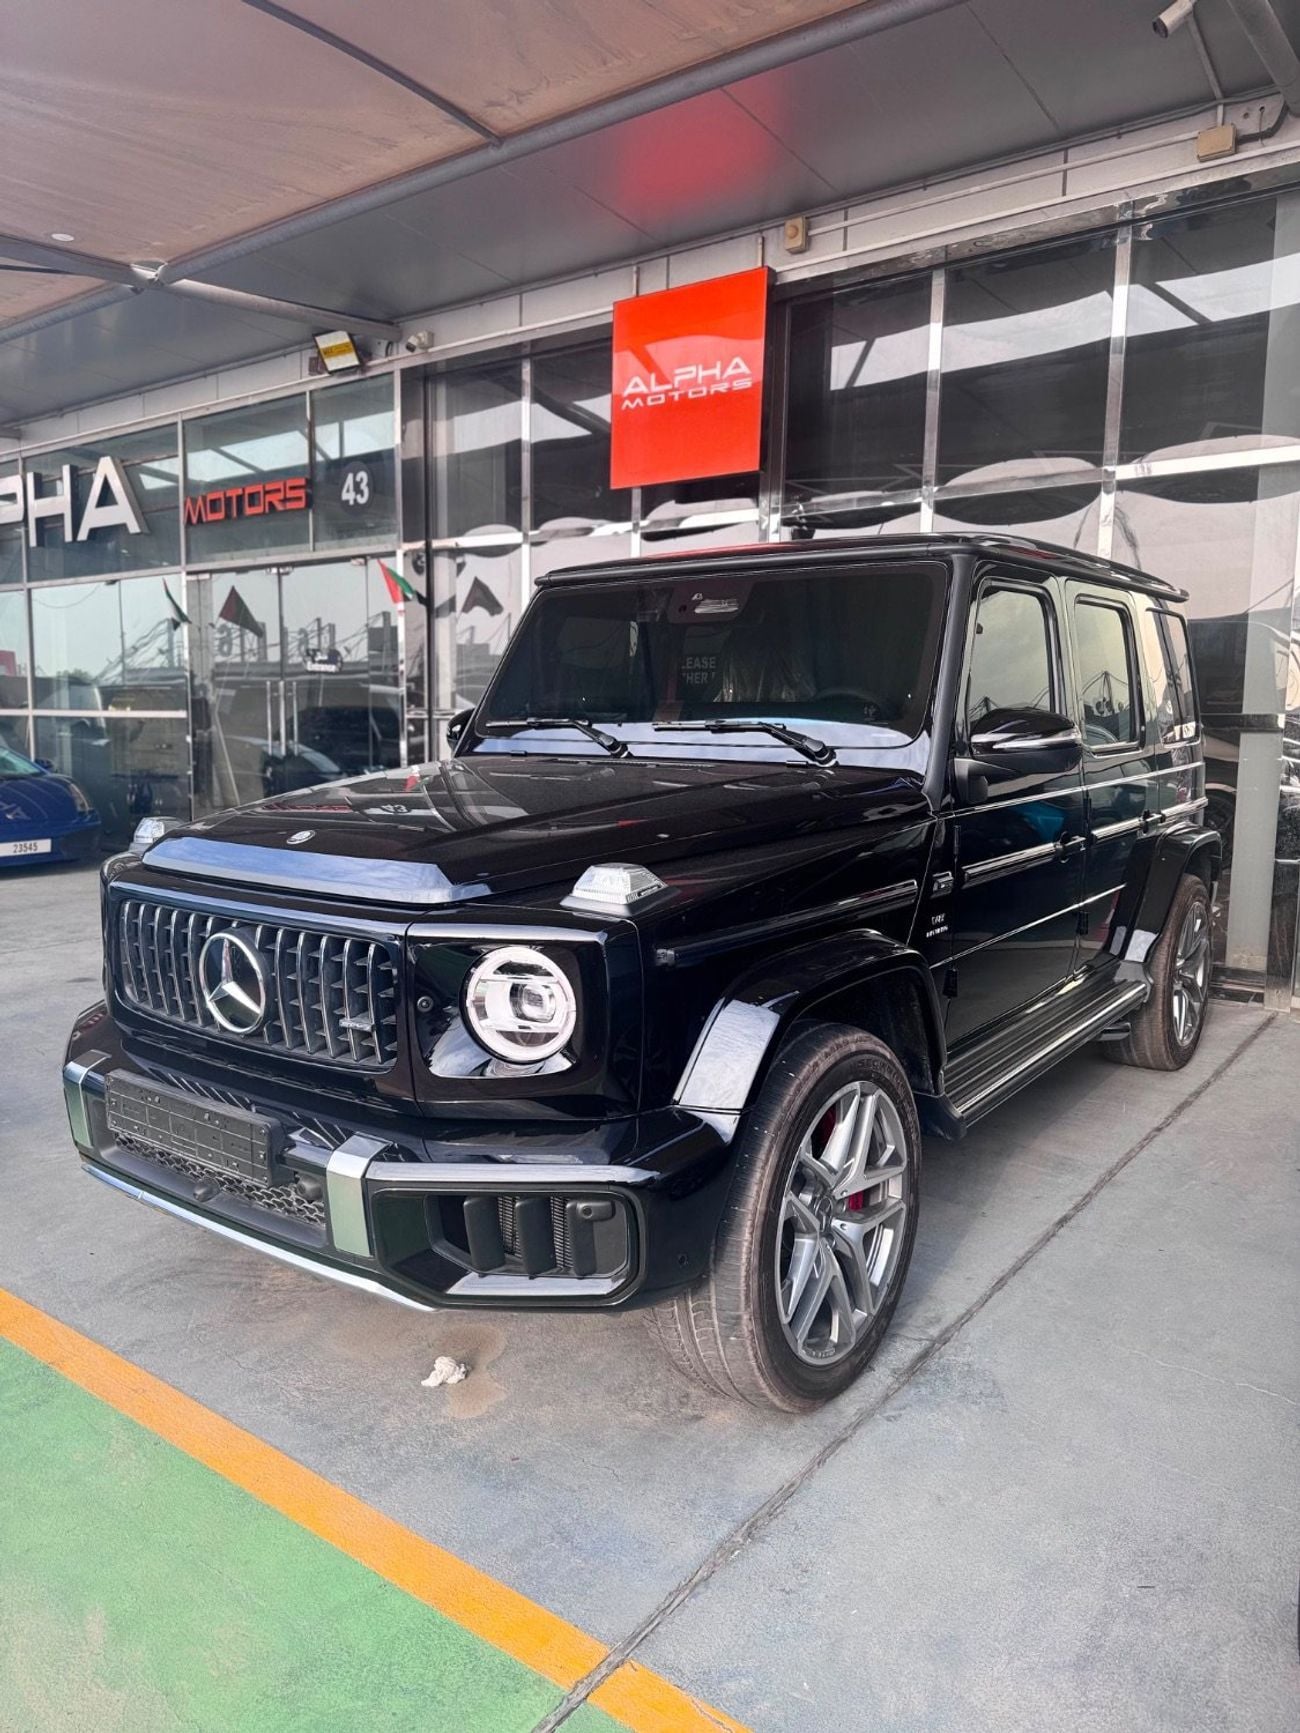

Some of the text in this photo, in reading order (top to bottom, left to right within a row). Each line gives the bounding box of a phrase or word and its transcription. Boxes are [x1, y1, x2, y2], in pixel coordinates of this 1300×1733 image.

[621, 377, 752, 411] MOTORS
[623, 356, 751, 397] ALPHA
[184, 477, 306, 525] MOTORS
[341, 470, 370, 506] 43
[13, 842, 38, 854] 23545
